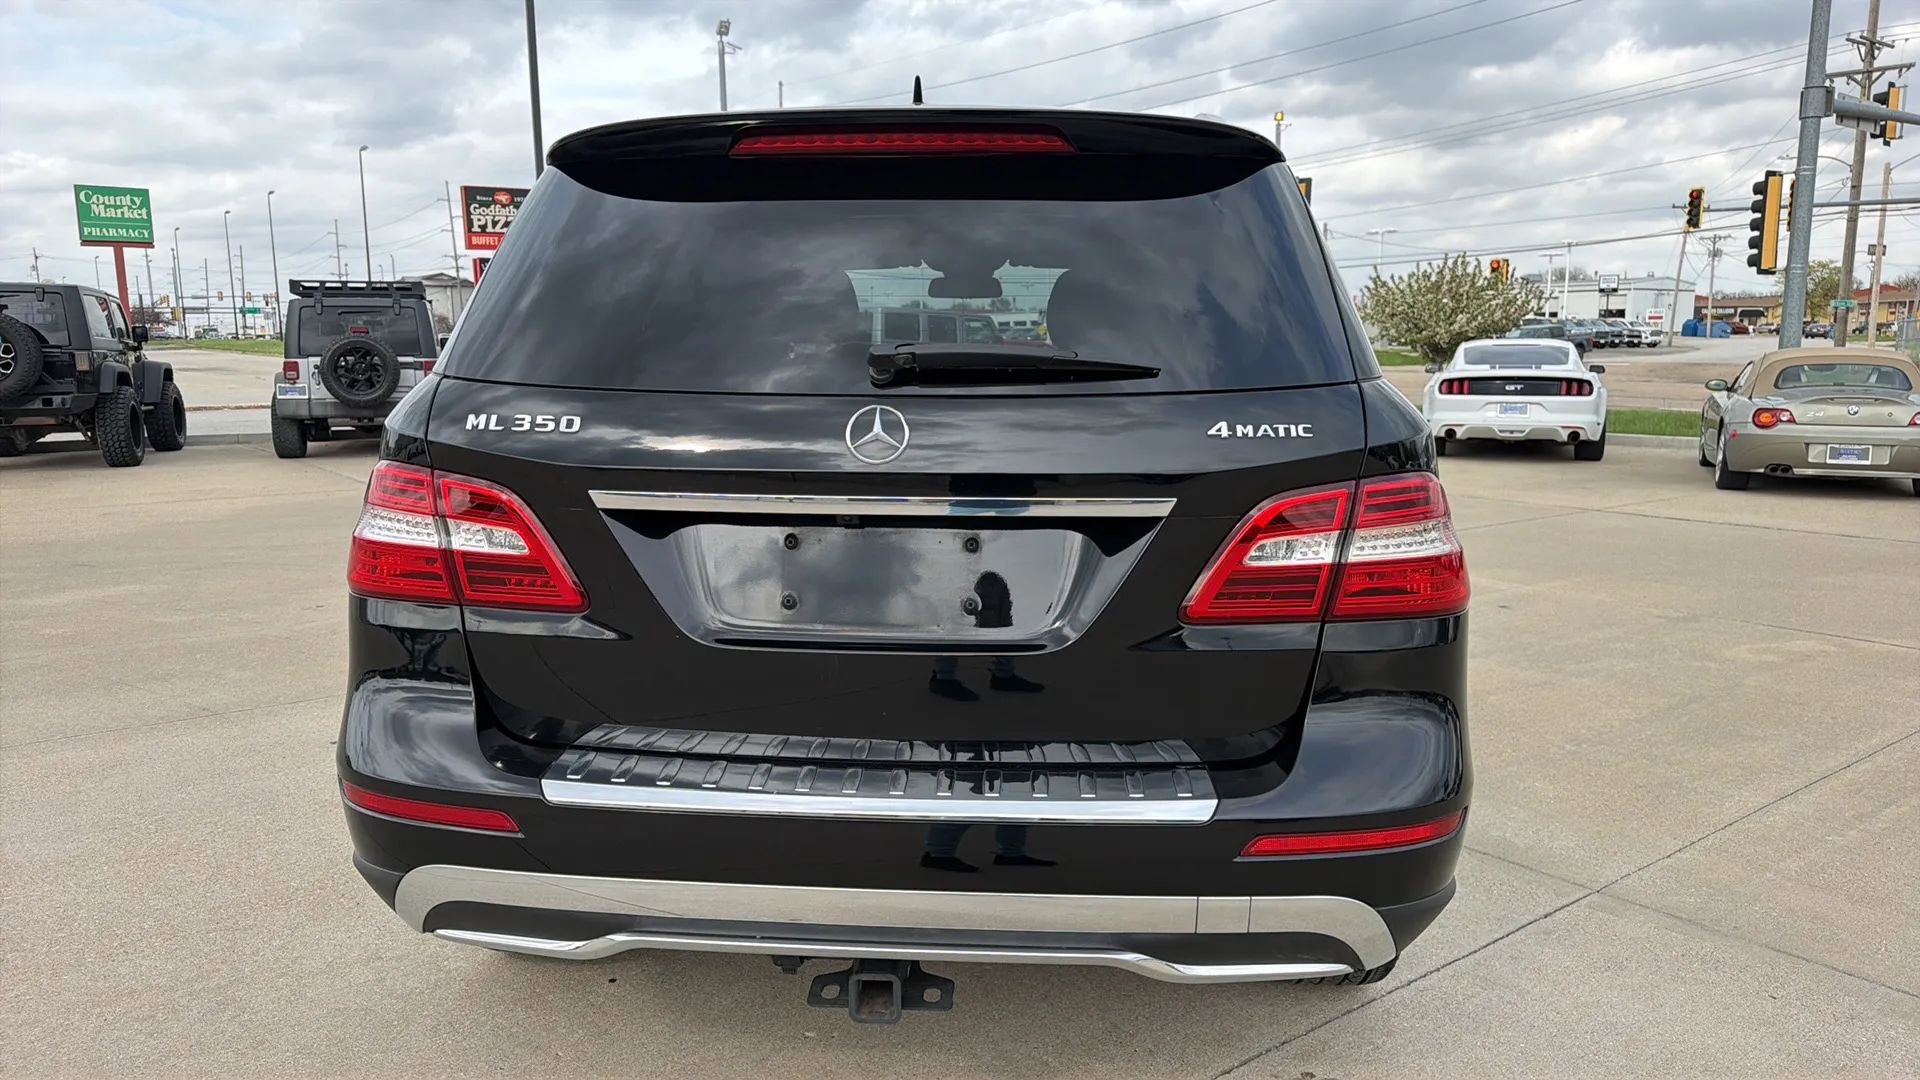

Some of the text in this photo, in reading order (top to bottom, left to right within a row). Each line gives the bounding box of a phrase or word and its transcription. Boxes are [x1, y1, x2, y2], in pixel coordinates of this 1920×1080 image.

[80, 190, 142, 208] County
[91, 204, 148, 219] Market
[470, 204, 517, 216] Godfath
[83, 227, 149, 238] PHARMACY
[472, 236, 499, 246] BUFFET
[465, 413, 581, 433] ML 350
